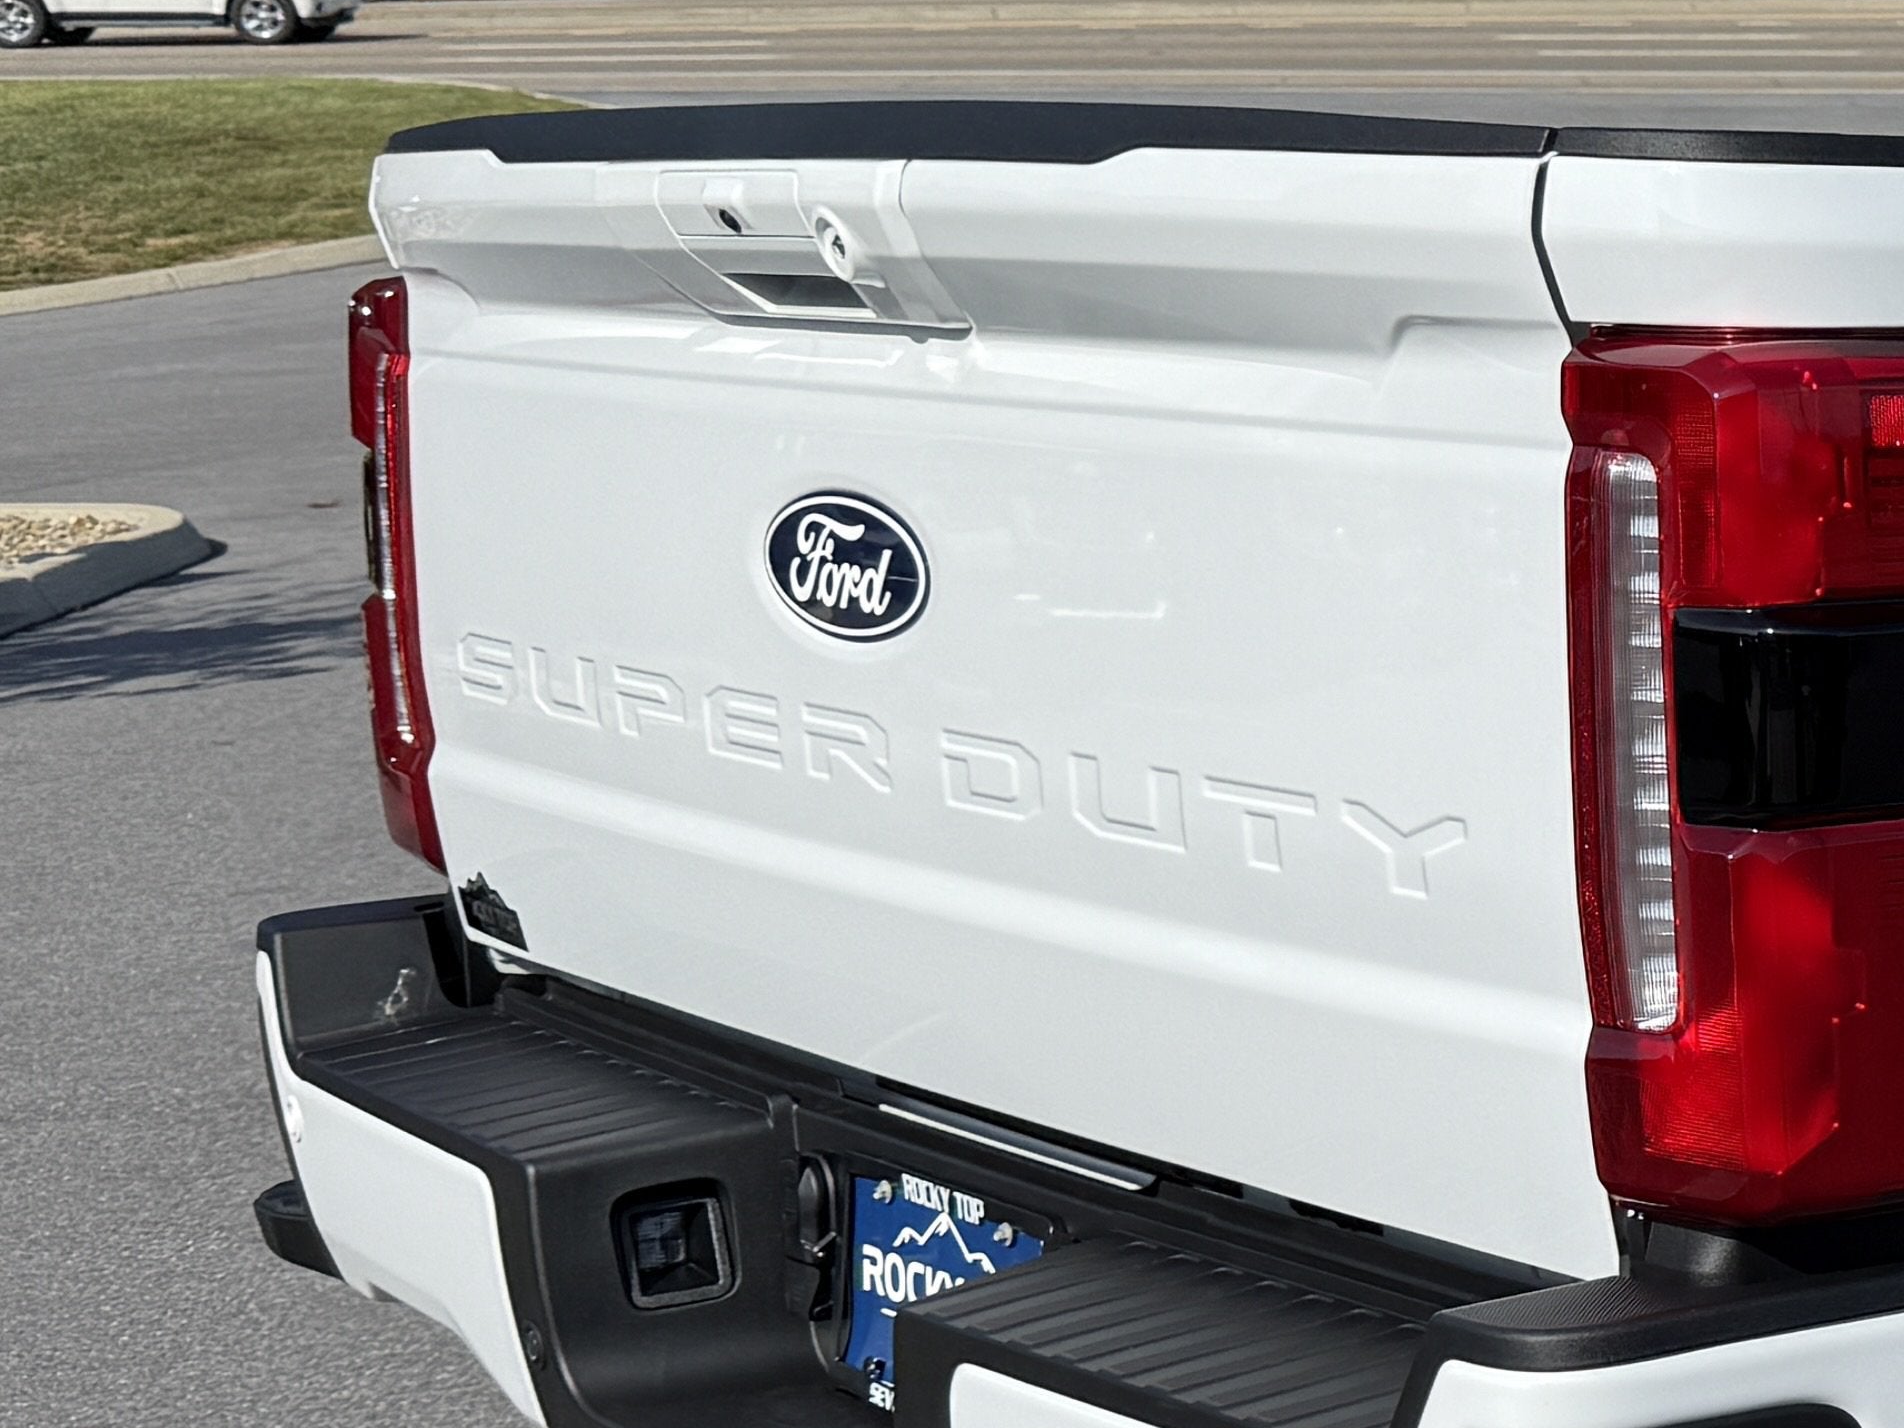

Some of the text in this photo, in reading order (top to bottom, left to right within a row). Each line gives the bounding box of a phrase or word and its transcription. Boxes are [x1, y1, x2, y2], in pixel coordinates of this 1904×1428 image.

[789, 512, 893, 616] Ford
[457, 631, 1468, 900] SUPER DUTY
[901, 1172, 985, 1225] ROCKY TOP
